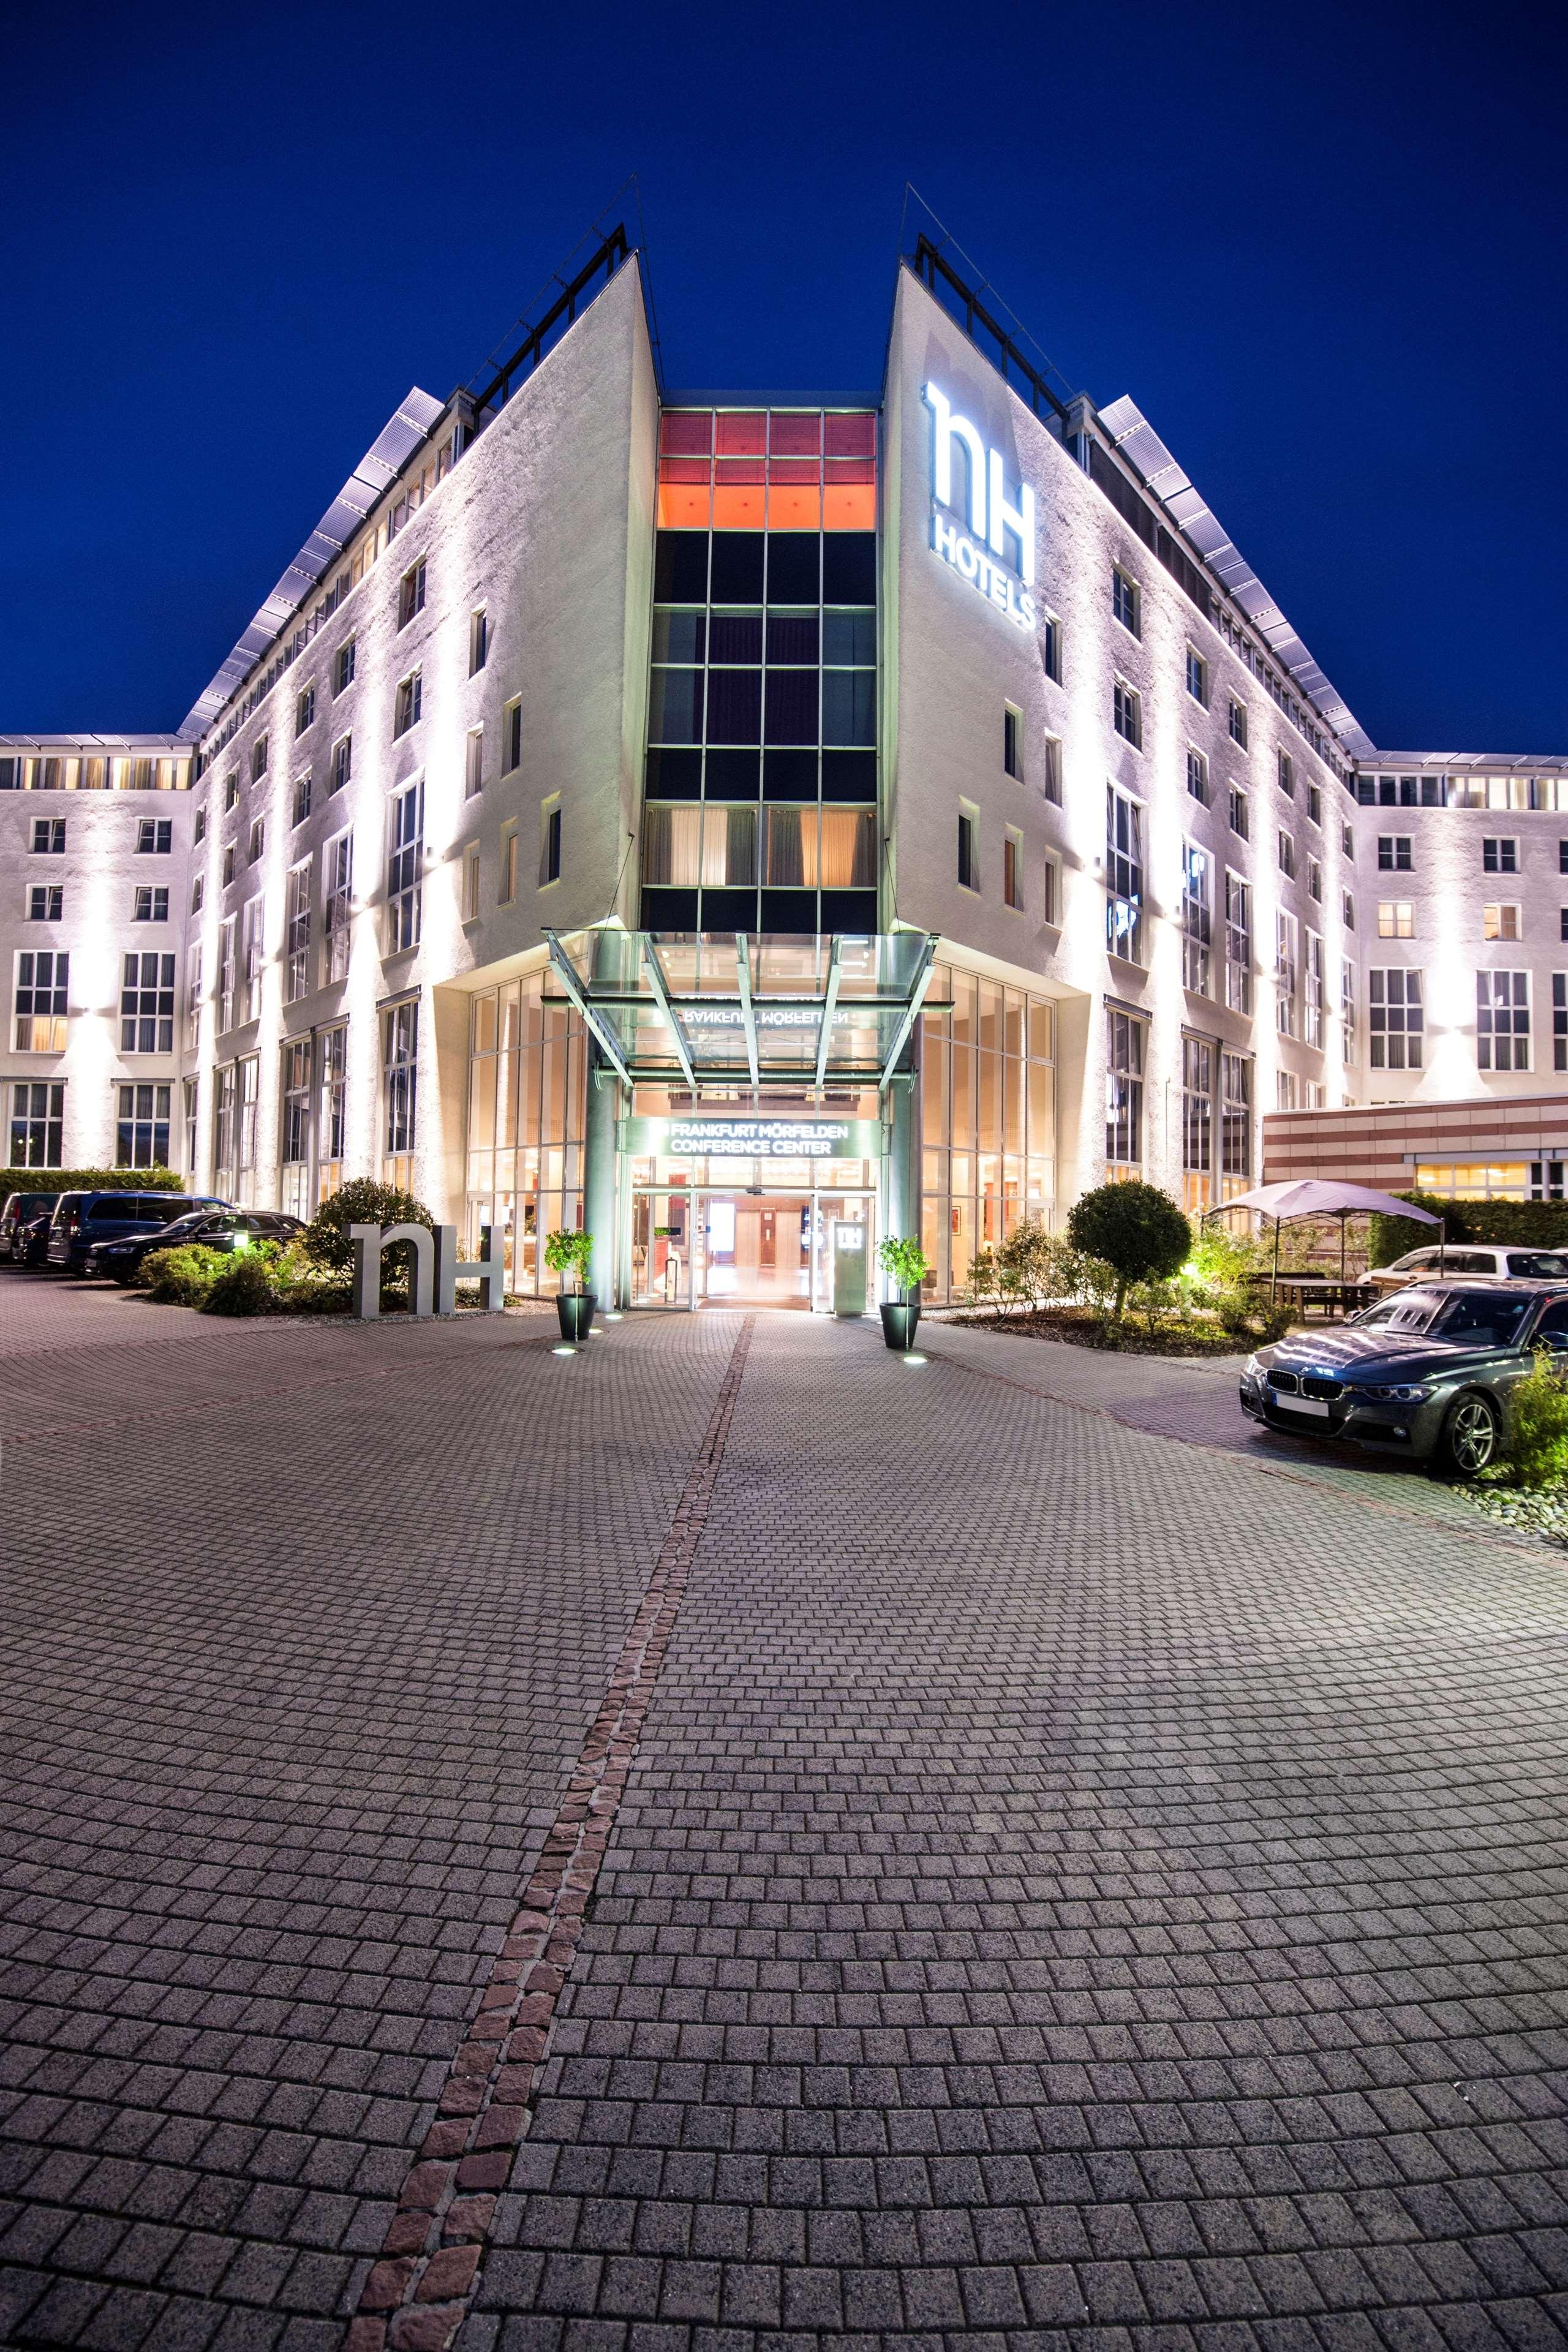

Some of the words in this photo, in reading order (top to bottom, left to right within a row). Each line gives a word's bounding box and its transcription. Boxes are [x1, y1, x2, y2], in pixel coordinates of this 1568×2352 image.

[935, 513, 1037, 631] HOTELS
[671, 1123, 758, 1137] FRANKFURT
[759, 1122, 848, 1139] MÖRFELDEN
[671, 1139, 771, 1154] CONFERENCE
[772, 1141, 832, 1154] CENTER
